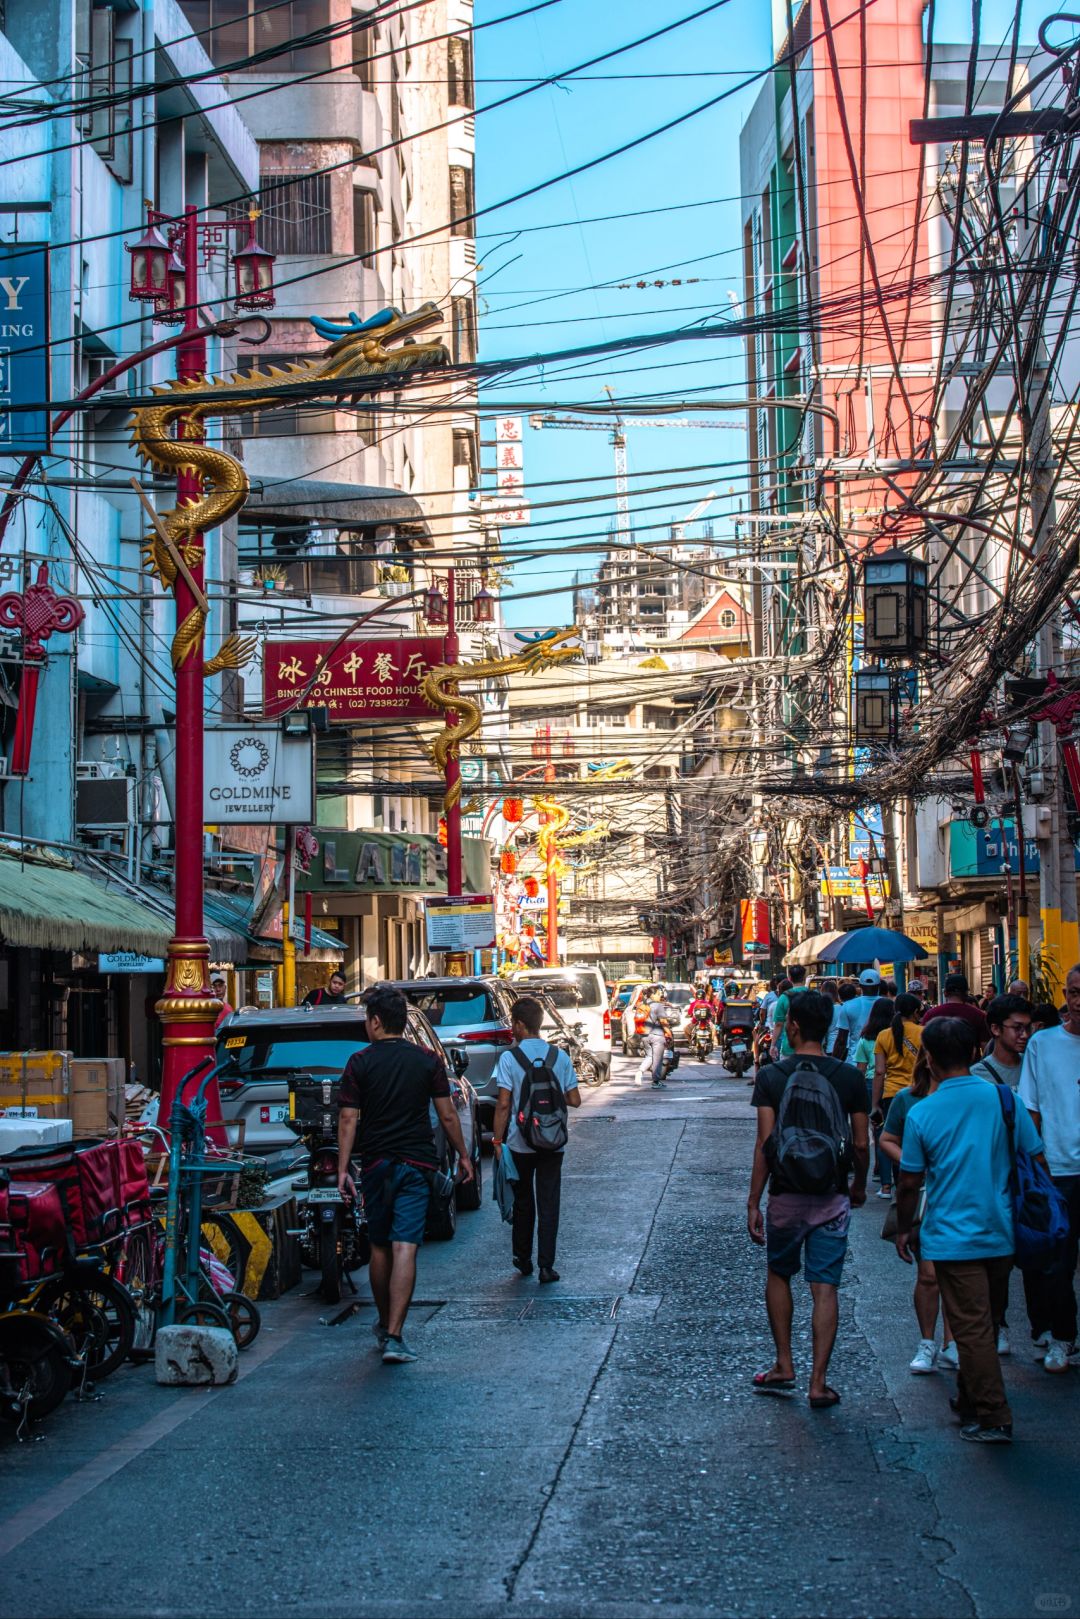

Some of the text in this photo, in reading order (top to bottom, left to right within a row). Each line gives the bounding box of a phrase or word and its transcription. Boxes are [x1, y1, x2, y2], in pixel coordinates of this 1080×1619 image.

[323, 686, 363, 697] CHINESE
[366, 686, 392, 695] FOOD
[348, 699, 367, 709] (02)
[209, 786, 291, 800] GOLDMINE
[225, 804, 275, 813] JEWELLERY
